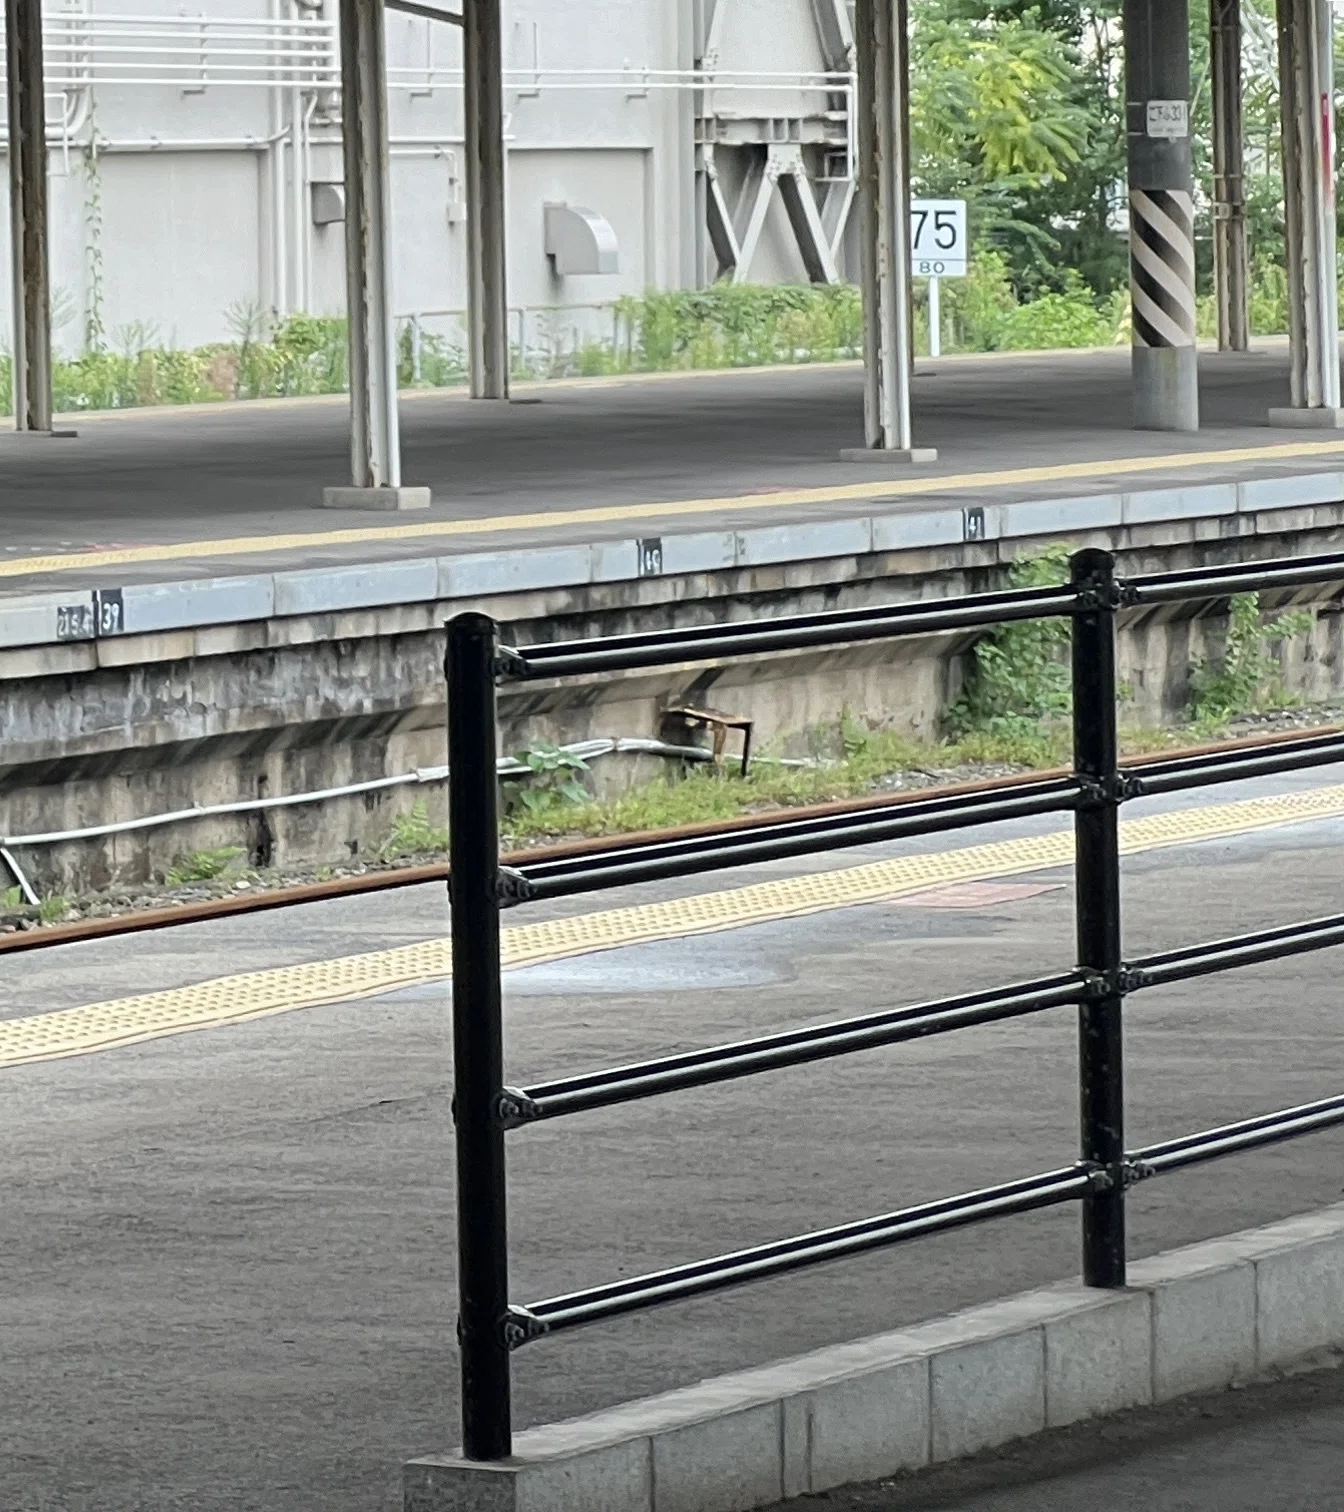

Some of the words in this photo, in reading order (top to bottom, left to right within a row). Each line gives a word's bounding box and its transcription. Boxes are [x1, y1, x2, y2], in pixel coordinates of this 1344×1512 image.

[911, 210, 957, 250] 75
[919, 261, 945, 274] 80
[102, 603, 120, 630] 39
